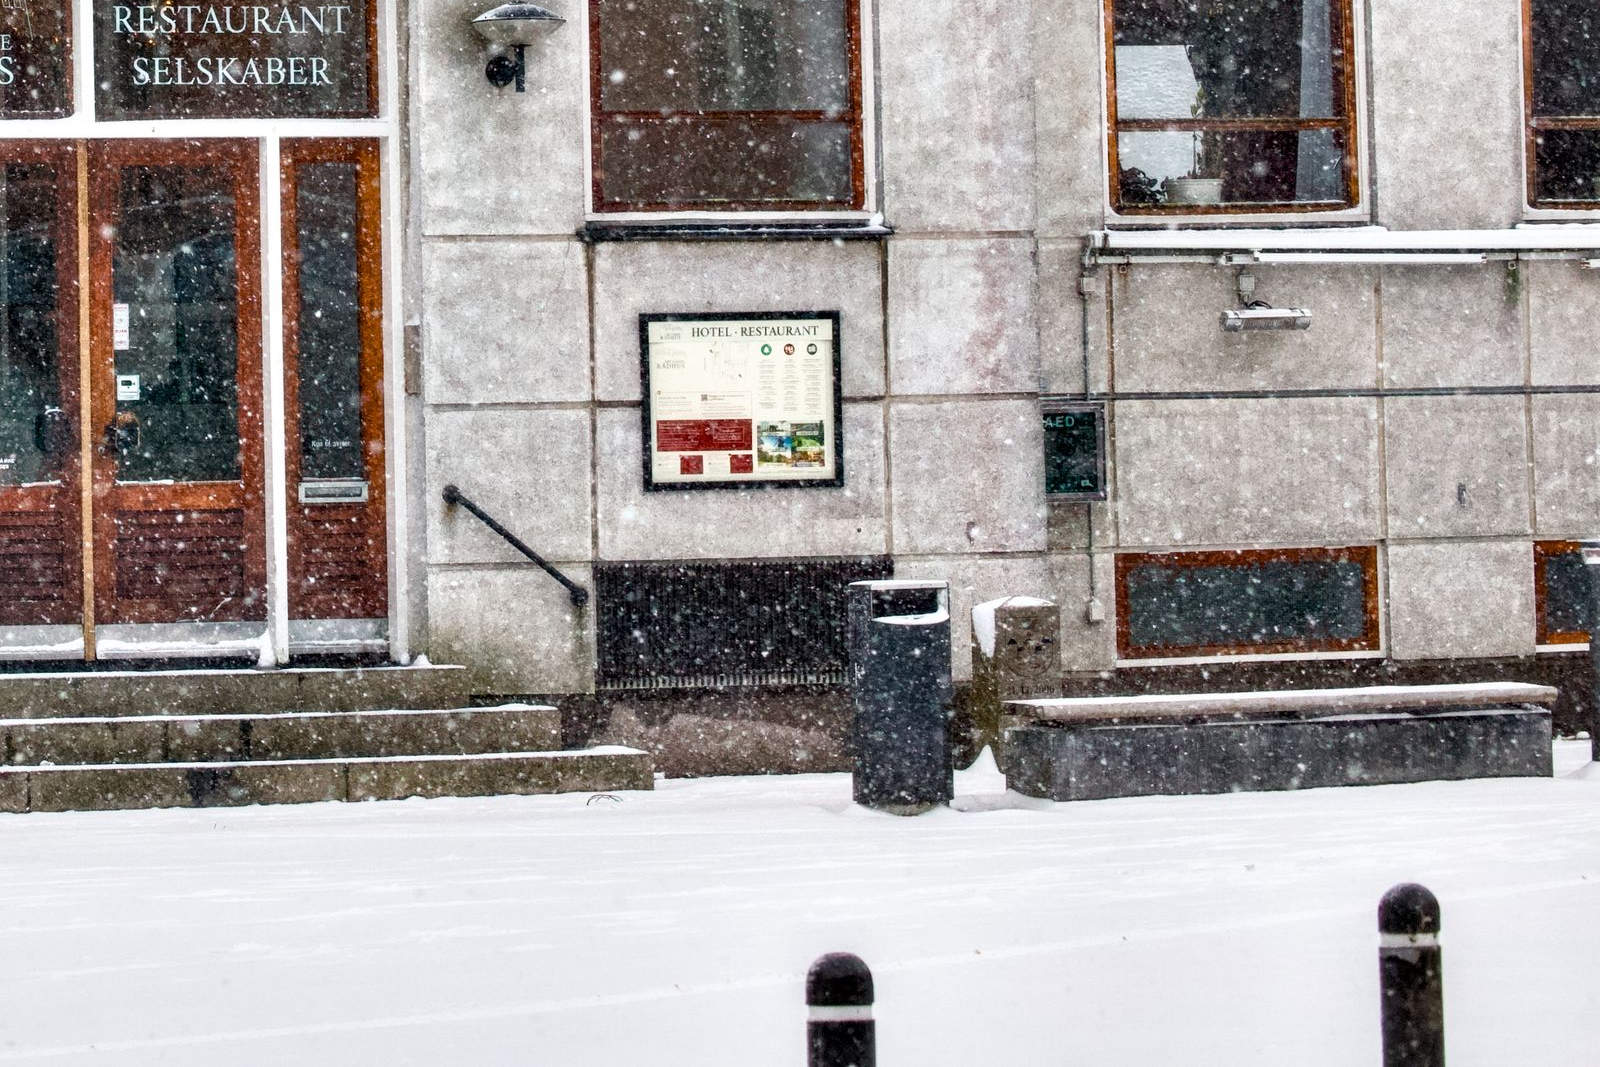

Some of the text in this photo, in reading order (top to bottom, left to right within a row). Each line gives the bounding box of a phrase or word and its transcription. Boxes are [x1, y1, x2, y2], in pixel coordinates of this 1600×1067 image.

[112, 4, 352, 36] RESTAURANT
[131, 56, 334, 86] SELSKABER
[691, 327, 733, 338] HOTEL
[740, 325, 820, 337] RESTAURANT
[1044, 415, 1075, 428] AED
